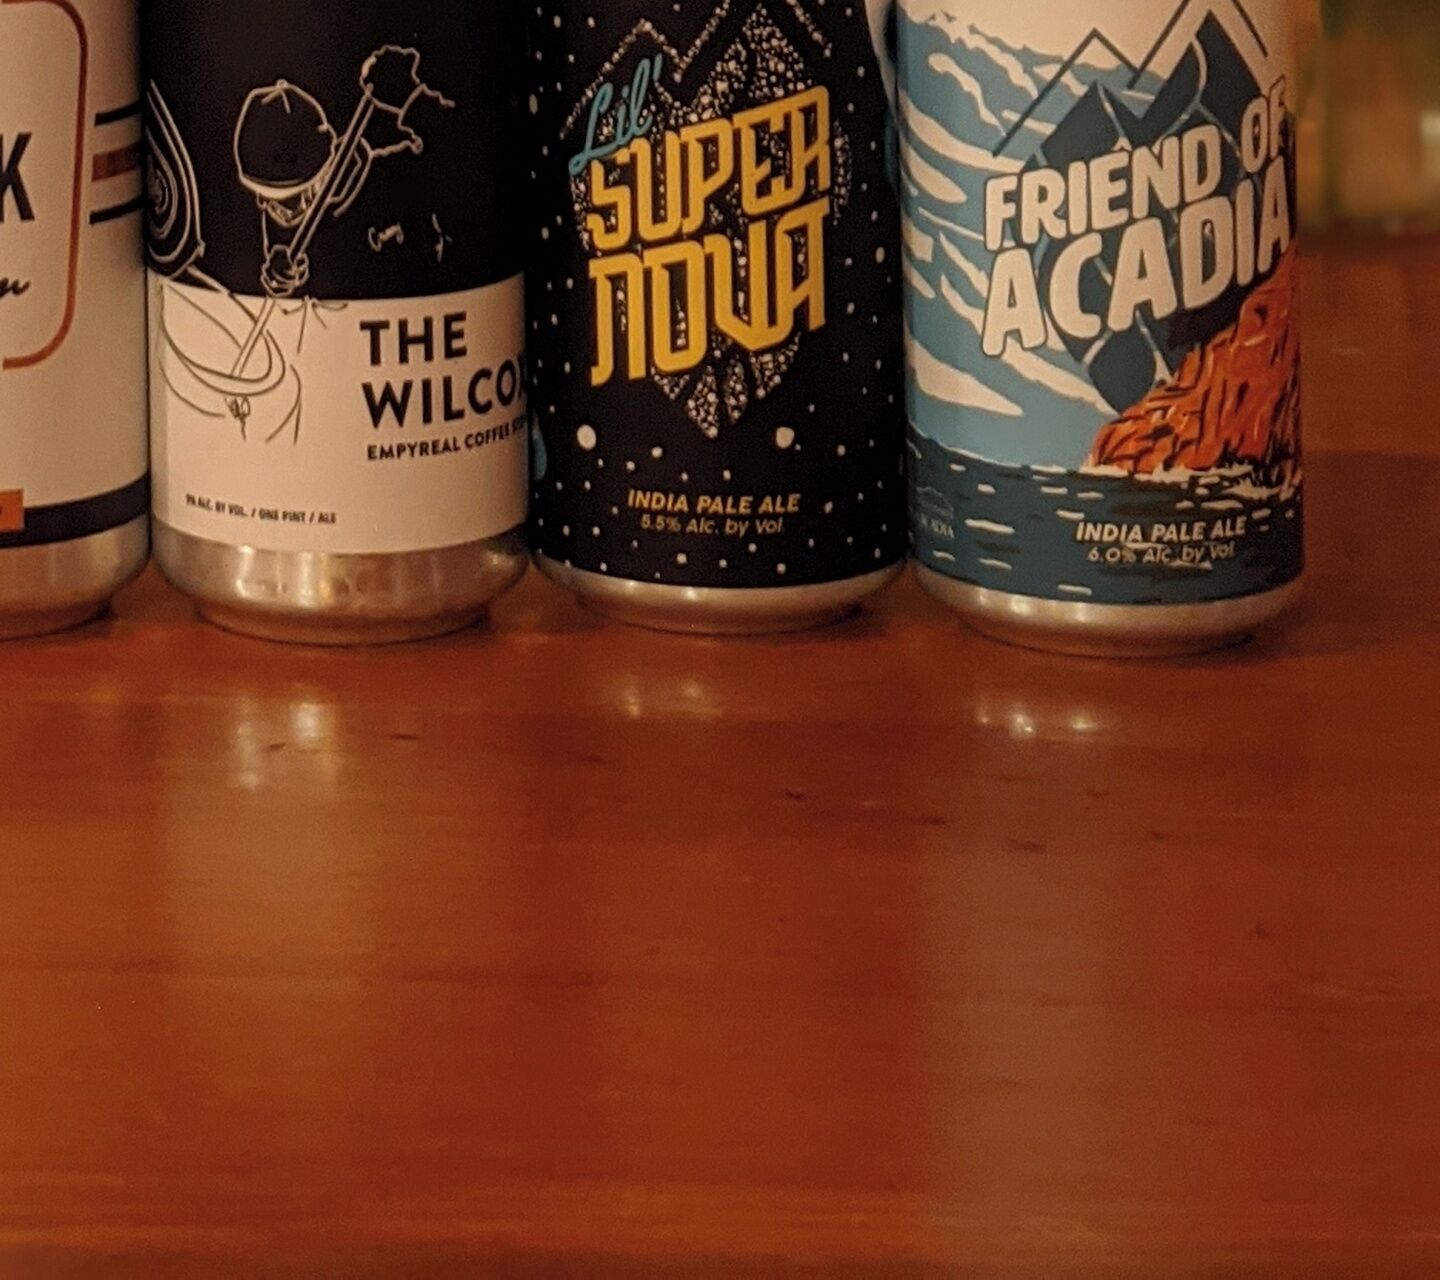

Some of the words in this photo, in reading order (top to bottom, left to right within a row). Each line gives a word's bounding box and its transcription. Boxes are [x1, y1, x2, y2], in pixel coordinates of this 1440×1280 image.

[586, 84, 831, 251] SUPER
[984, 123, 1222, 252] FRIEND
[1240, 75, 1288, 175] OF
[981, 154, 1291, 357] ACADIA
[588, 195, 830, 387] NOVA
[360, 310, 468, 367] THE
[367, 436, 461, 461] EMPYREAL
[626, 488, 690, 513] INDIA
[696, 494, 754, 515] PALE
[759, 492, 802, 514] ALE
[724, 517, 749, 538] by
[1075, 521, 1143, 543] INDIA
[1150, 521, 1207, 543] PALE
[1211, 515, 1248, 539] ALE
[1182, 544, 1204, 565] by
